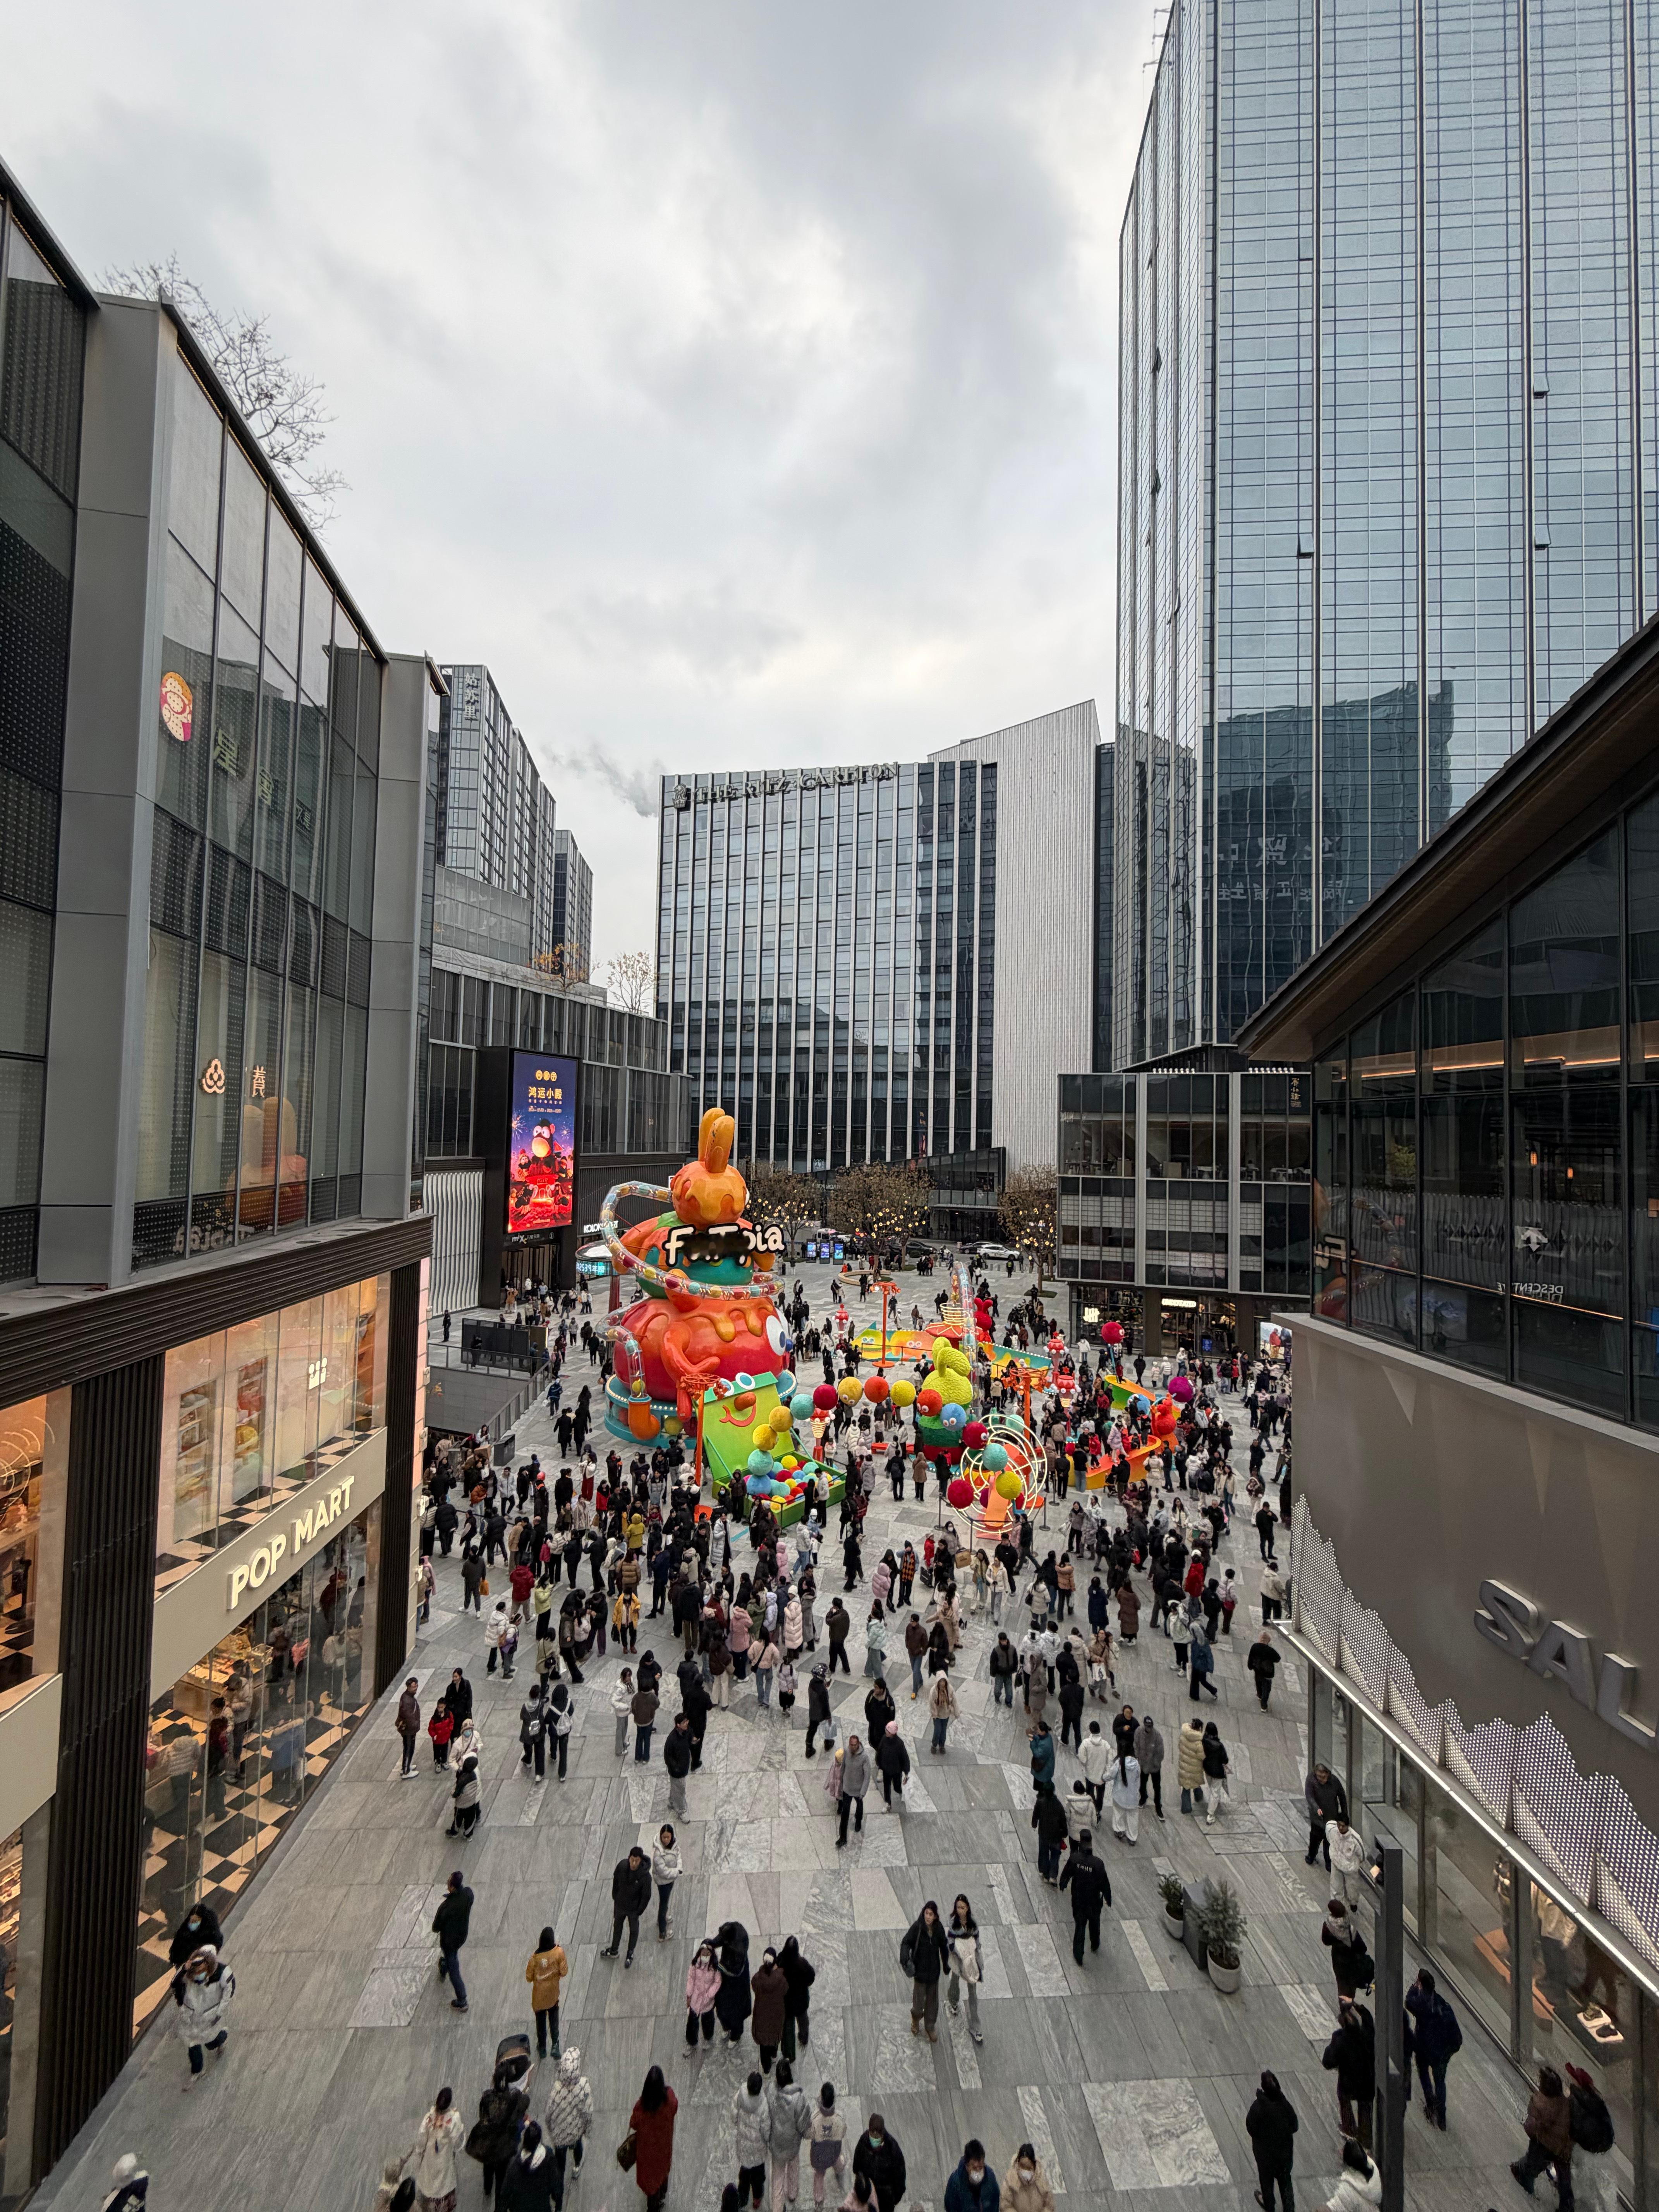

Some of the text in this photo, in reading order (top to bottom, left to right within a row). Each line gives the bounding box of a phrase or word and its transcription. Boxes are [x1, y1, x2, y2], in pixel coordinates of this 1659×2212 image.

[464, 672, 479, 718] 姑苏里
[695, 761, 899, 801] THE RITZ CARLTON
[529, 1086, 562, 1100] 鸿运小殿
[228, 1475, 355, 1610] POP MART
